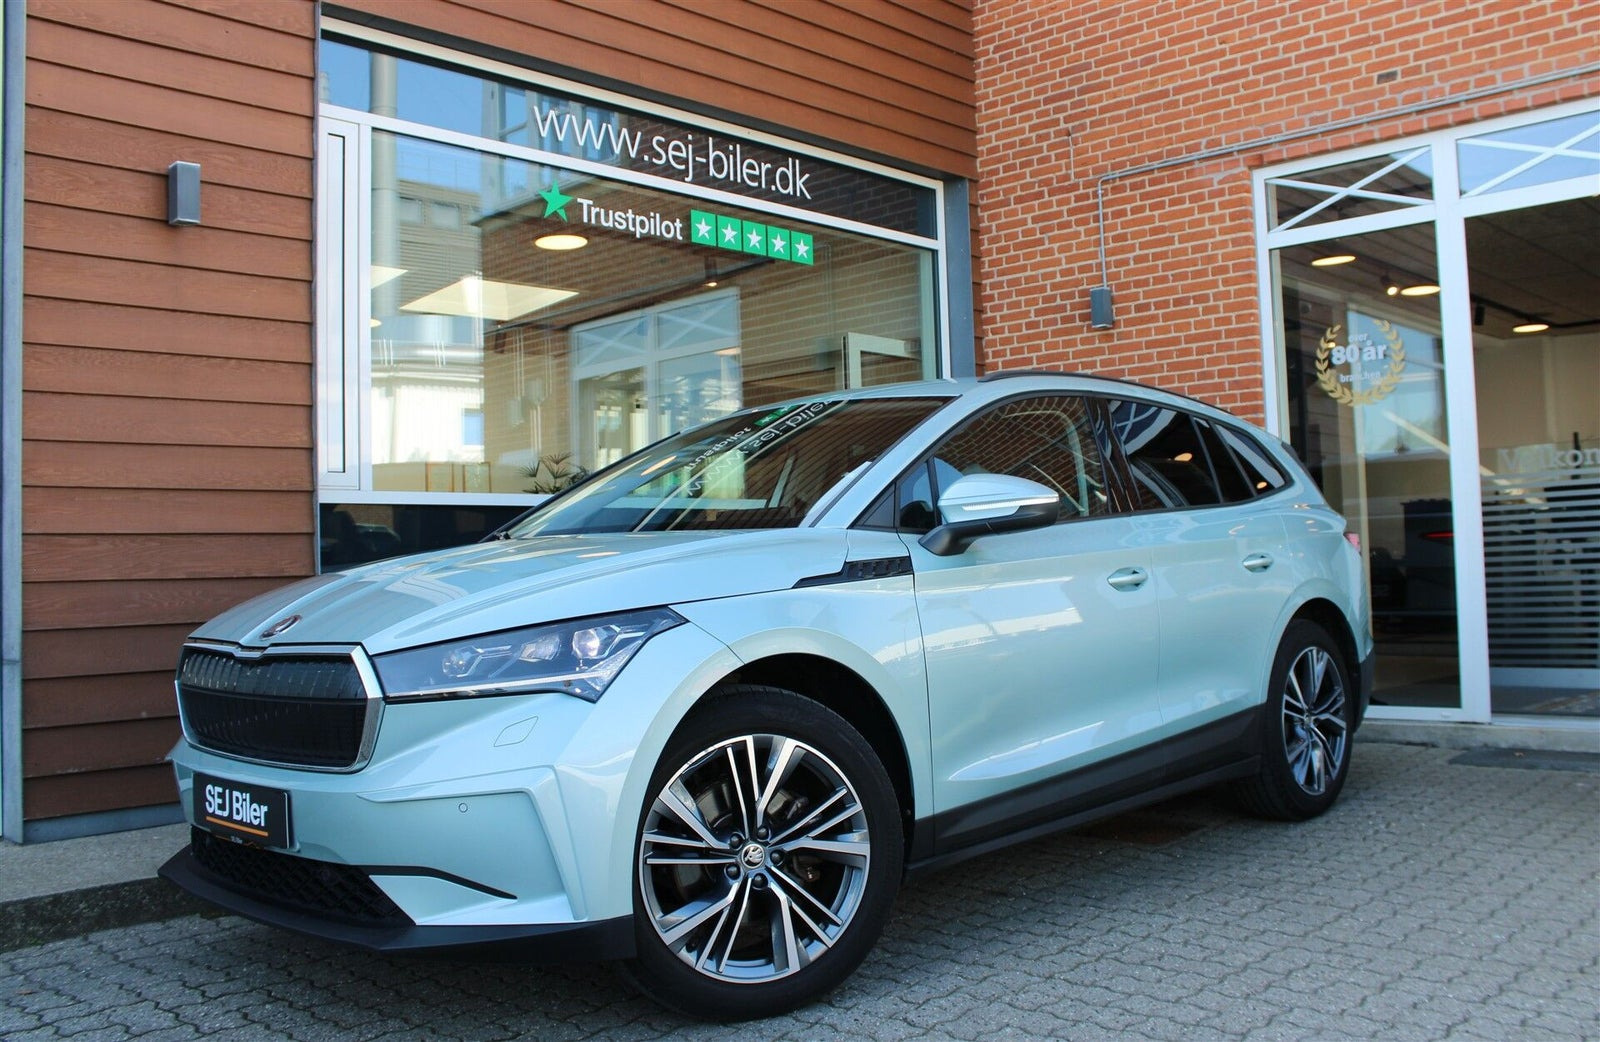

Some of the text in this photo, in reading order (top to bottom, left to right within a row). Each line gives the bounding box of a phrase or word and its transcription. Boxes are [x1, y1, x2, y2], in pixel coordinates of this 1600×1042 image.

[533, 105, 812, 200] www.sej-biler.dk
[577, 197, 684, 241] Trustpilot
[1331, 340, 1387, 365] 80 år
[205, 784, 268, 827] SEJ Biler
